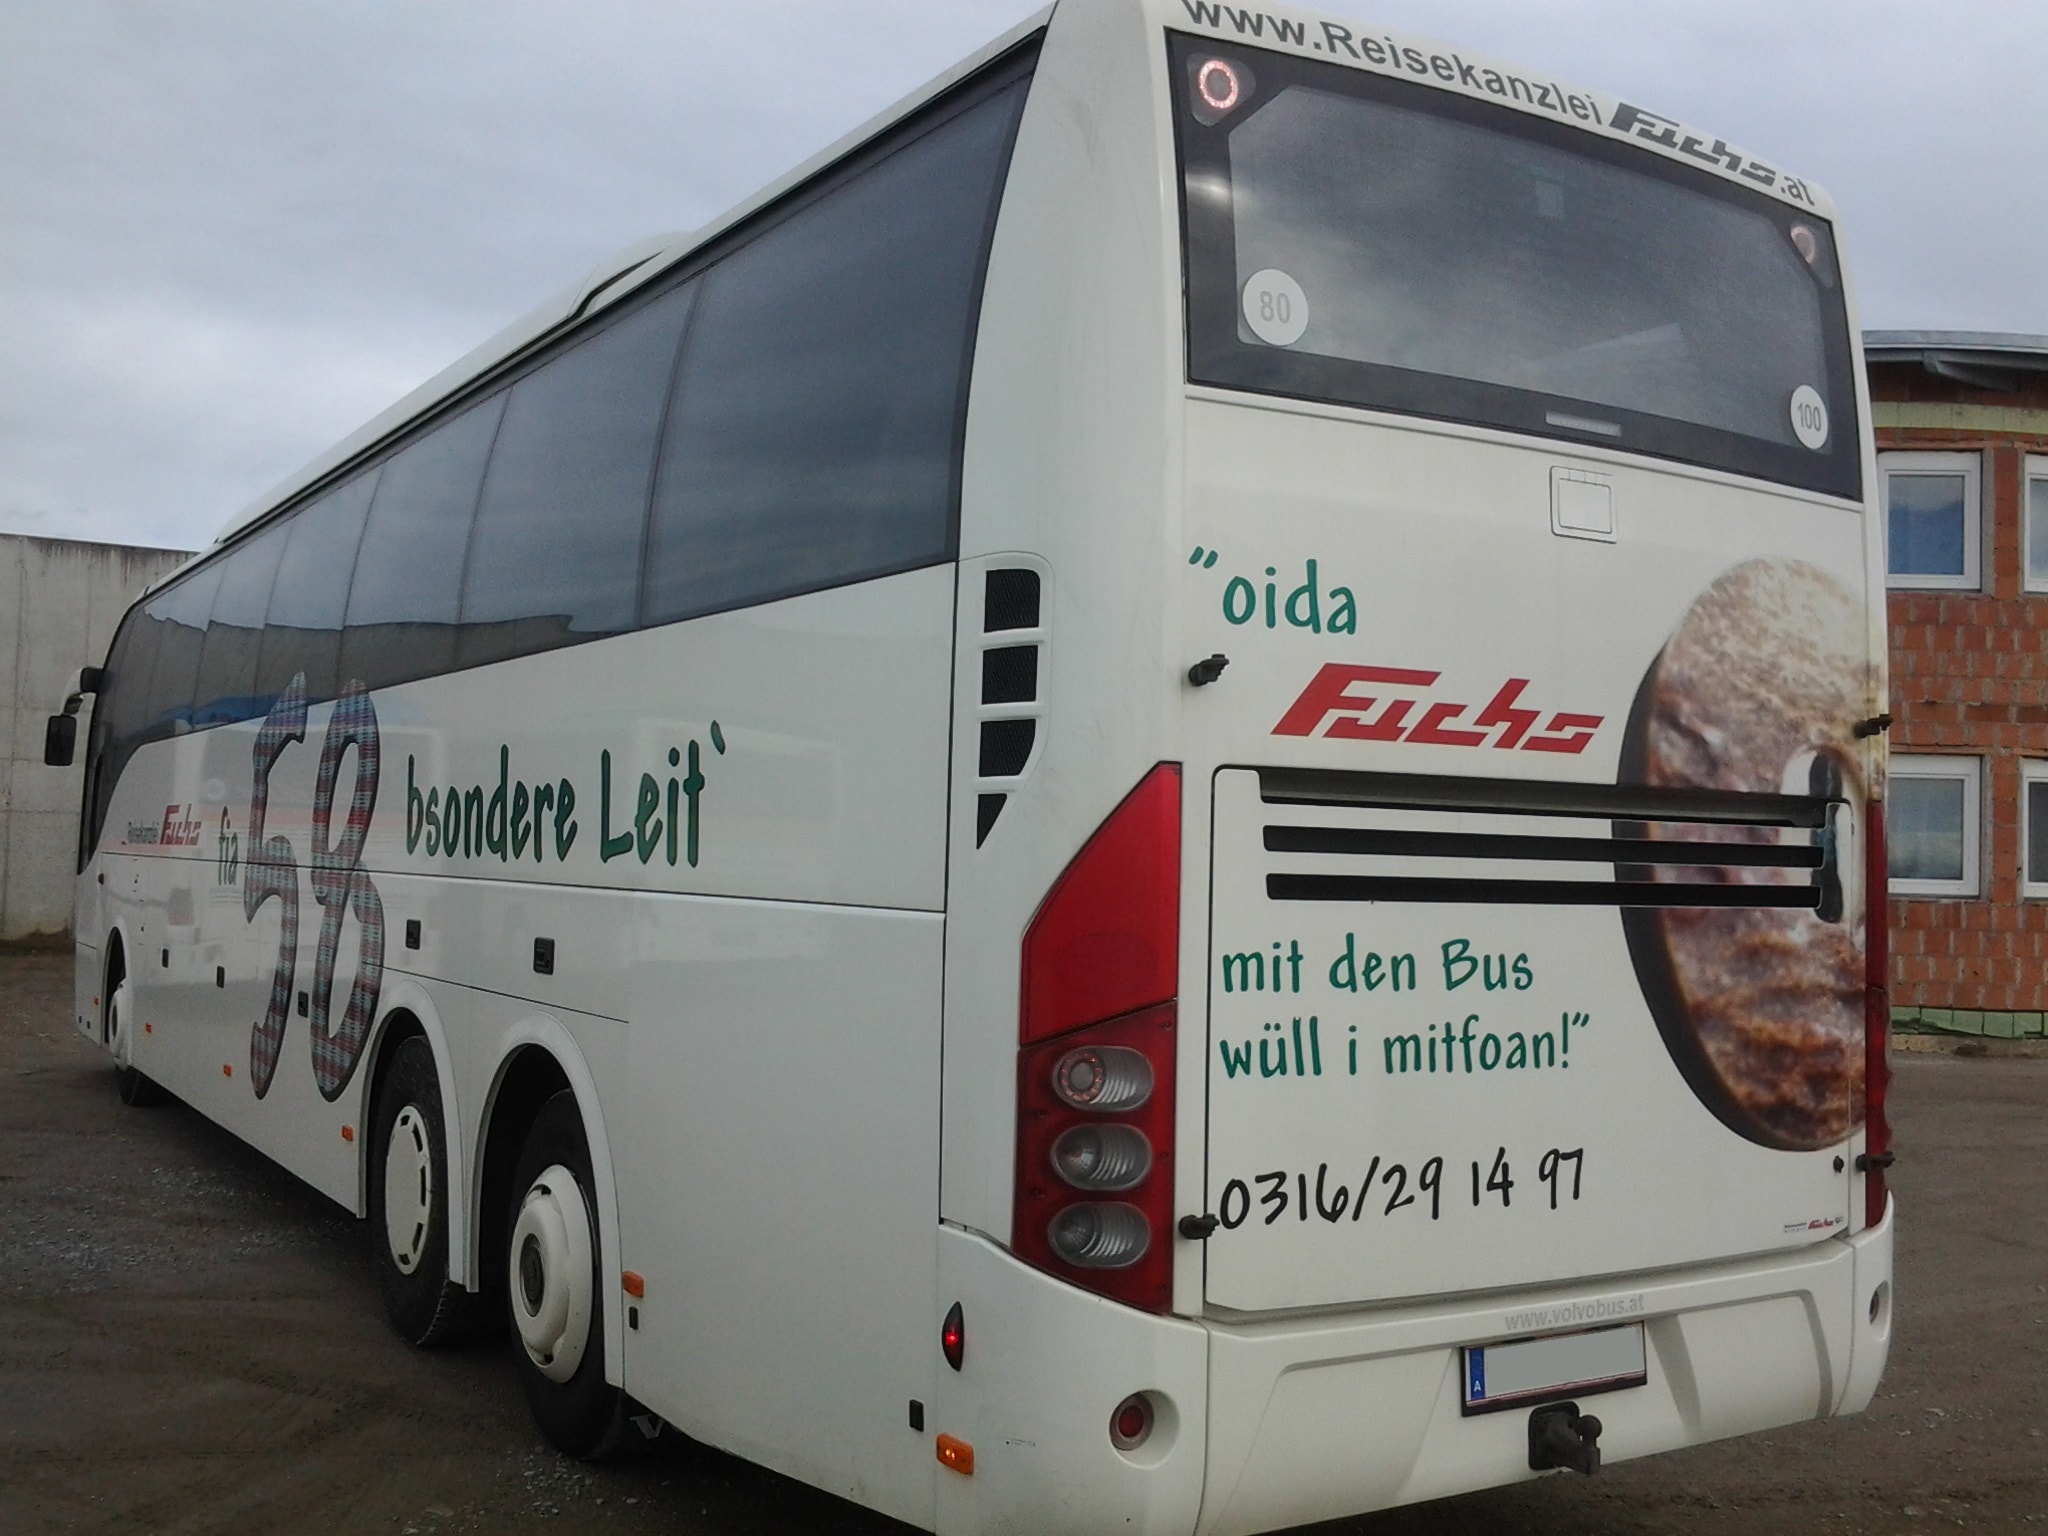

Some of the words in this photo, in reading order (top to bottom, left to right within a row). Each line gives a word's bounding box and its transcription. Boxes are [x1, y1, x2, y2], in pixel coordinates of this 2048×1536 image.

[1258, 290, 1292, 325] 80
[1798, 400, 1822, 433] 100
[1270, 661, 1605, 755] Fuchs
[160, 803, 202, 846] Fuchs
[244, 671, 385, 1103] 58
[407, 743, 578, 863] bsondere
[1222, 940, 1304, 993] mit
[1329, 932, 1416, 993] den
[1441, 938, 1533, 991] Bus
[1219, 1015, 1322, 1079] wüll
[1348, 1025, 1357, 1075] i
[1219, 1155, 1444, 1230] 0316/29
[1472, 1146, 1515, 1208] 14
[1538, 1147, 1584, 1210] 97
[1505, 1294, 1645, 1331] www.volvobus.at
[1473, 1379, 1482, 1393] A
